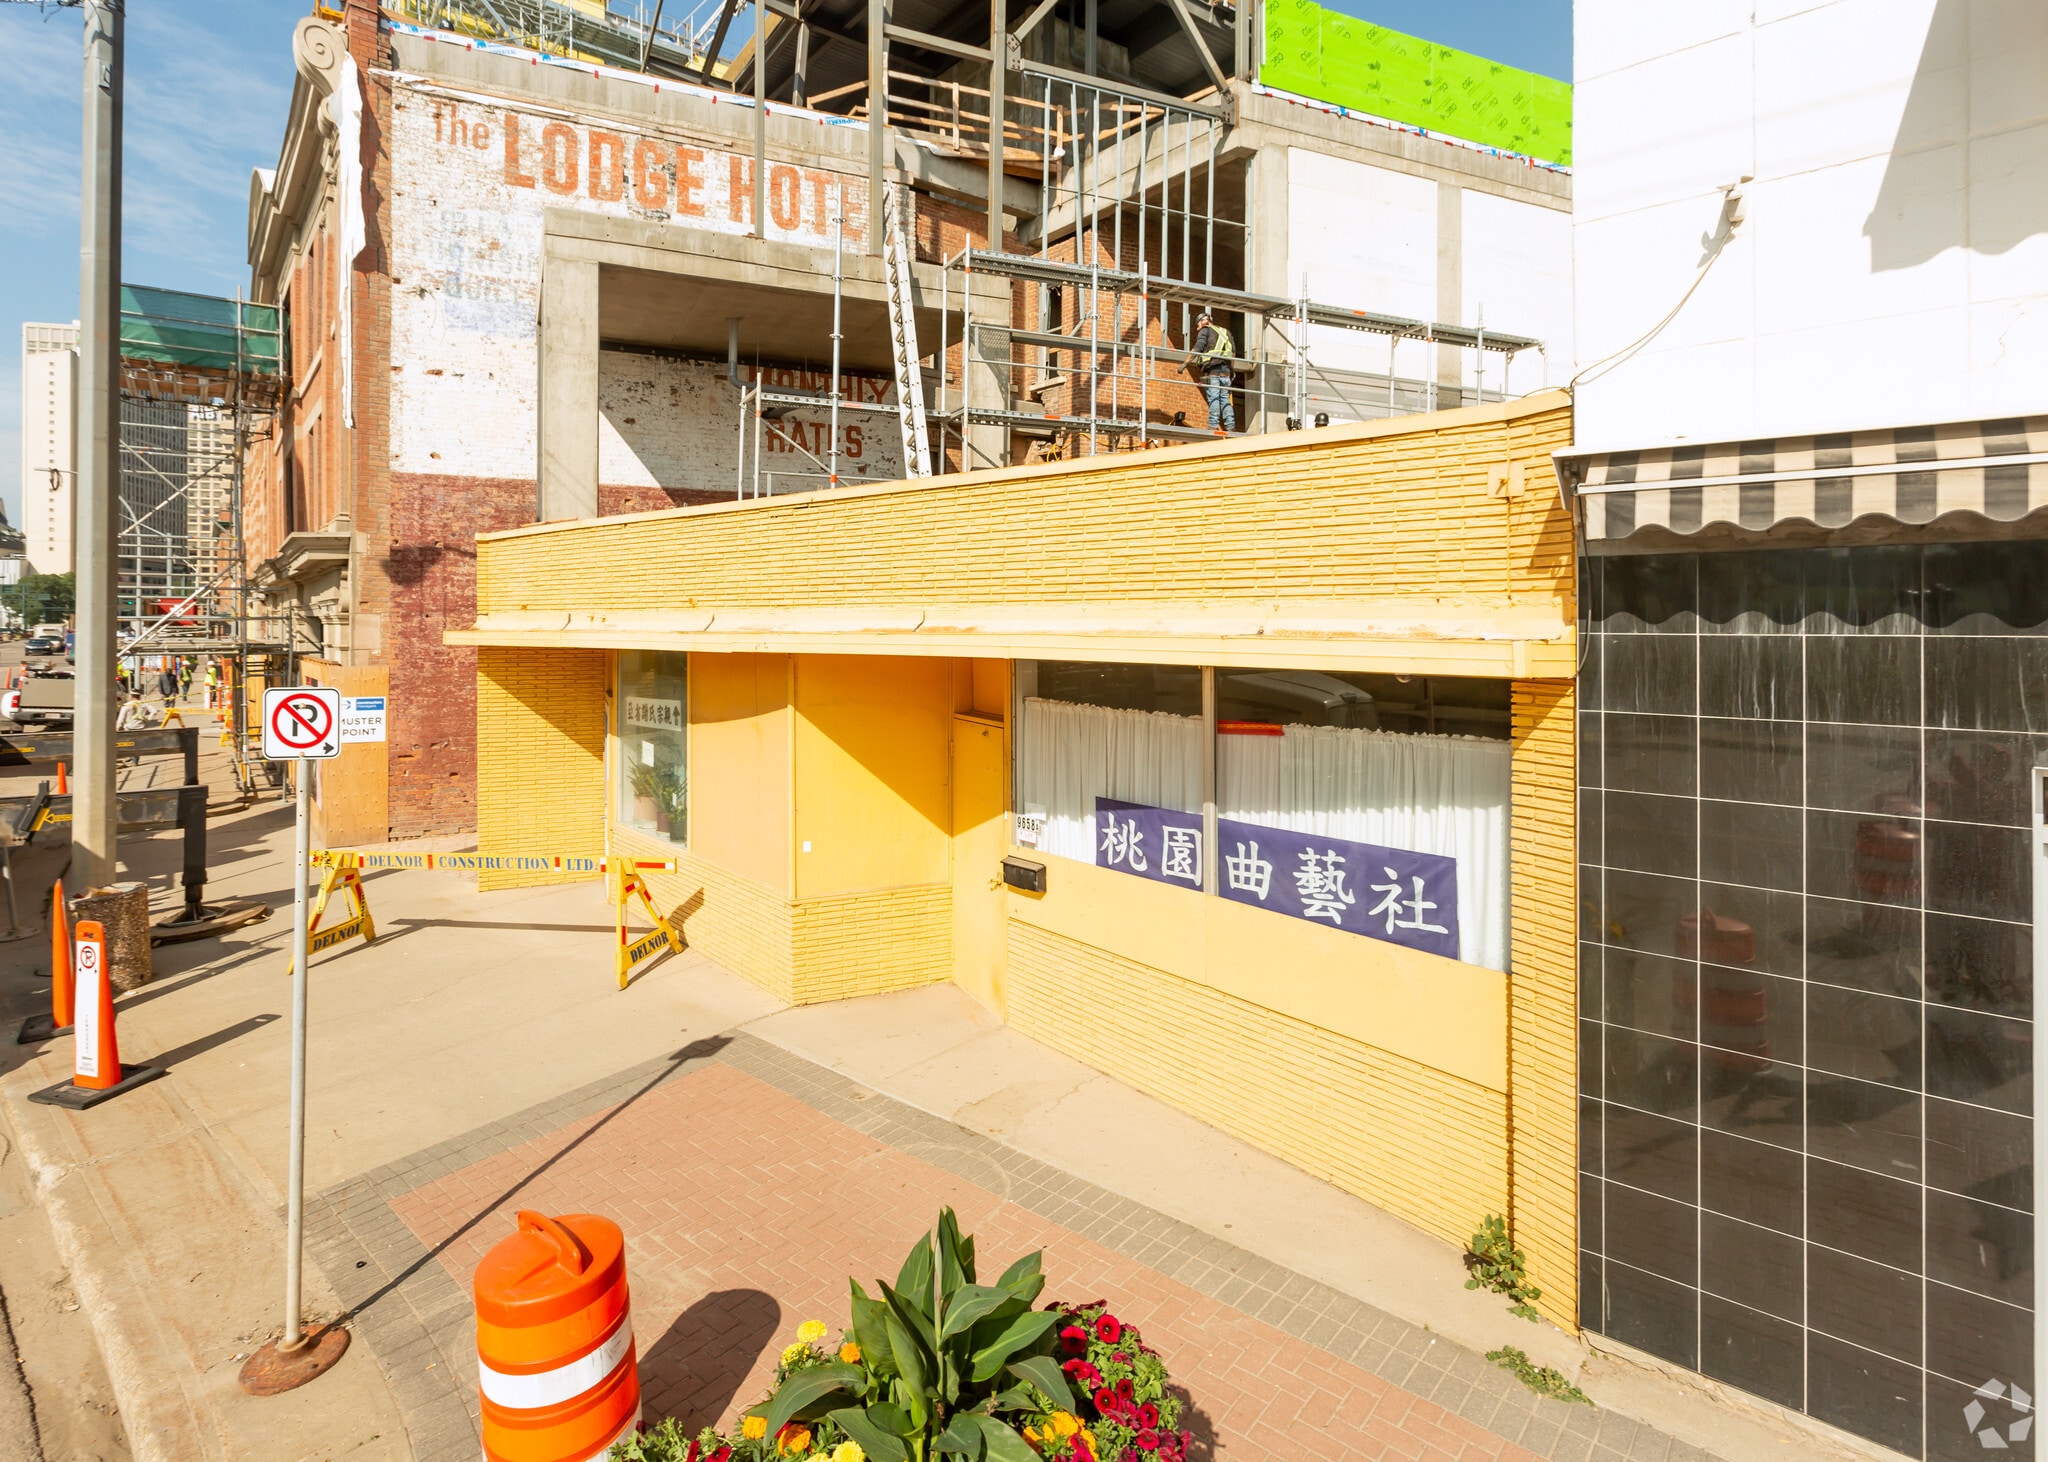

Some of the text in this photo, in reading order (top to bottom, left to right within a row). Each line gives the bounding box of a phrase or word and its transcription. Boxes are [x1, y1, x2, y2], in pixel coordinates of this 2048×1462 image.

[432, 100, 490, 151] The
[504, 113, 704, 218] LODGE
[342, 727, 377, 737] POINT
[369, 855, 424, 868] DELNOR
[438, 856, 550, 871] CONSTRUCTION
[629, 930, 670, 965] DELNOR
